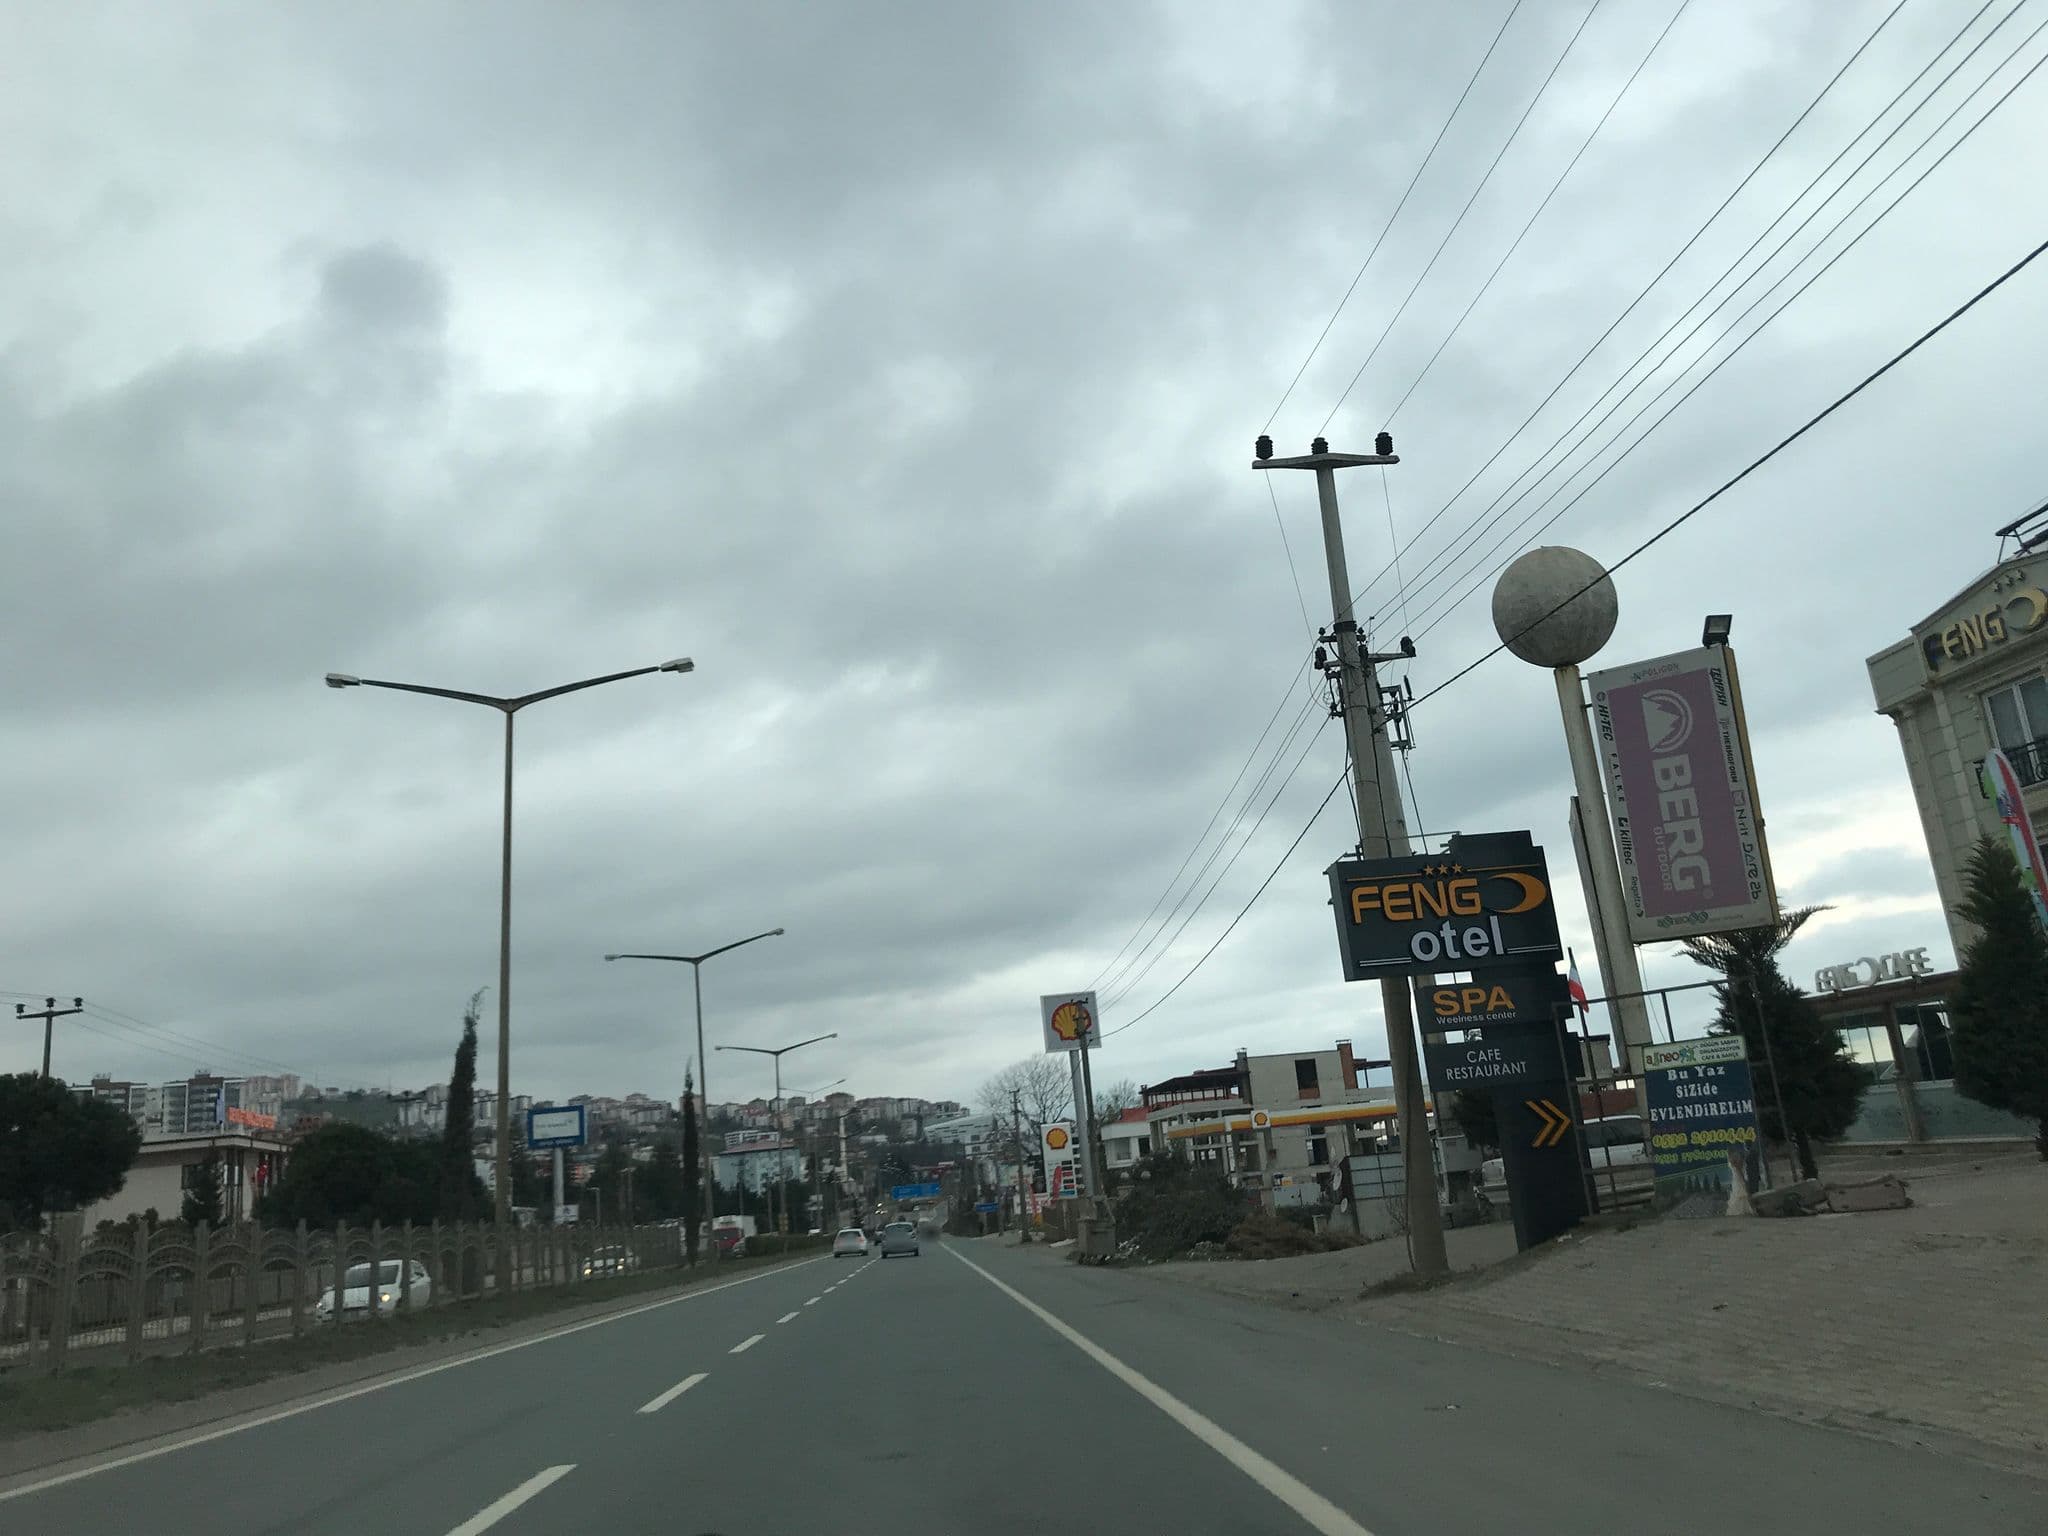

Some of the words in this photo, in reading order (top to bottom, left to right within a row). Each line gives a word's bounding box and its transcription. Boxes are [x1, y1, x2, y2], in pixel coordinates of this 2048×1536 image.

[1653, 753, 1711, 893] BERG
[1619, 828, 1633, 866] killtec
[1654, 826, 1673, 891] OUTDOOR
[1351, 877, 1482, 925] FENG
[1631, 874, 1641, 910] Regatta
[1410, 915, 1506, 962] otel
[1432, 986, 1516, 1017] SPA
[1486, 1011, 1517, 1021] center
[1445, 1061, 1527, 1081] RESTAURANT
[1466, 1048, 1502, 1064] CAFE
[1667, 1068, 1689, 1081] Bu
[1695, 1065, 1726, 1078] Yaz
